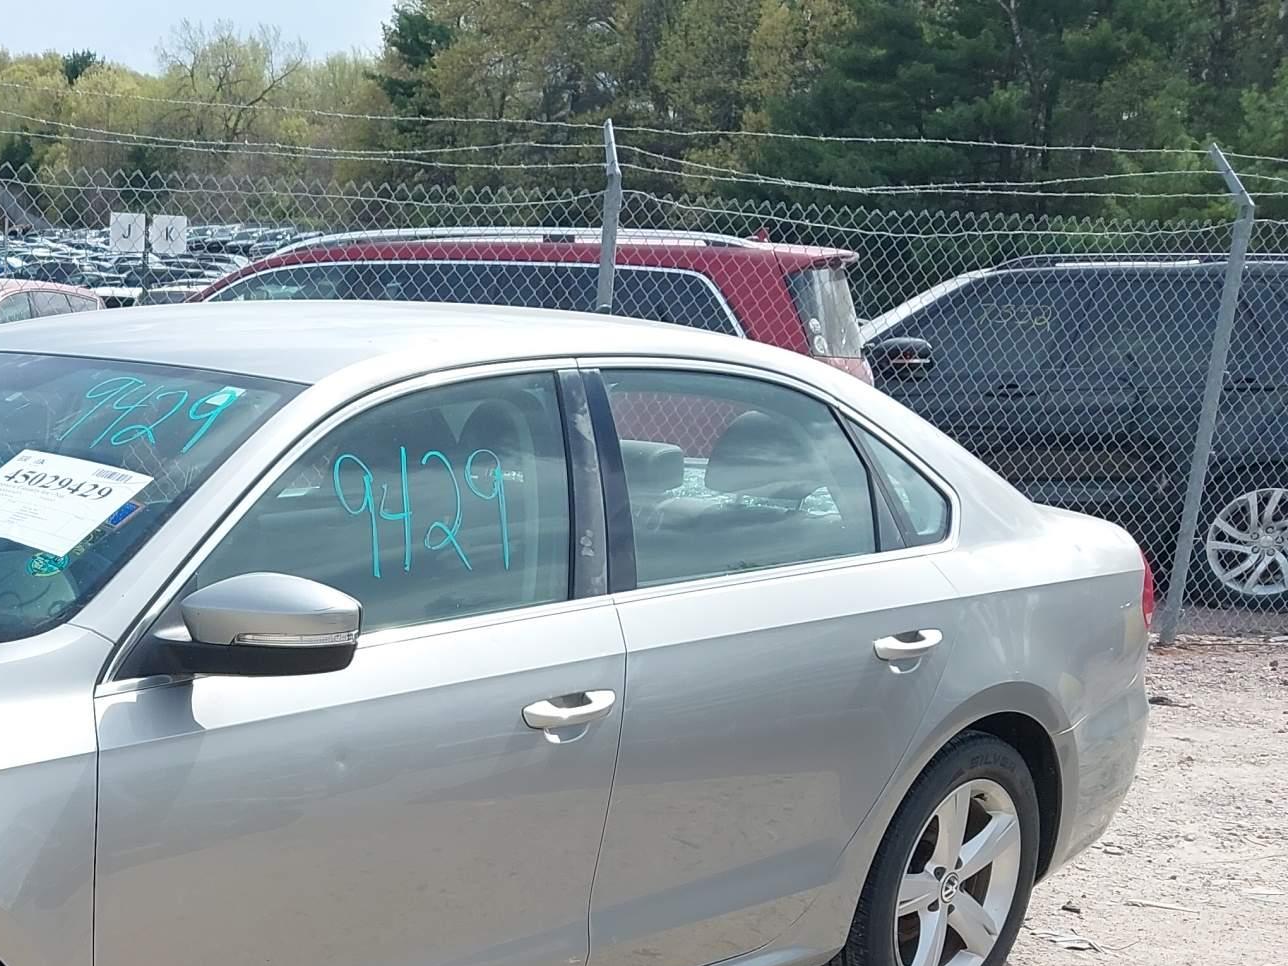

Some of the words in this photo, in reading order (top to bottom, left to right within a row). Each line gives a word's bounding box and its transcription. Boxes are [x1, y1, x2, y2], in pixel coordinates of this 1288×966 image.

[122, 223, 132, 239] J
[165, 225, 176, 241] K
[56, 376, 238, 454] 9429
[3, 468, 114, 501] 45029429
[333, 445, 510, 578] 9429
